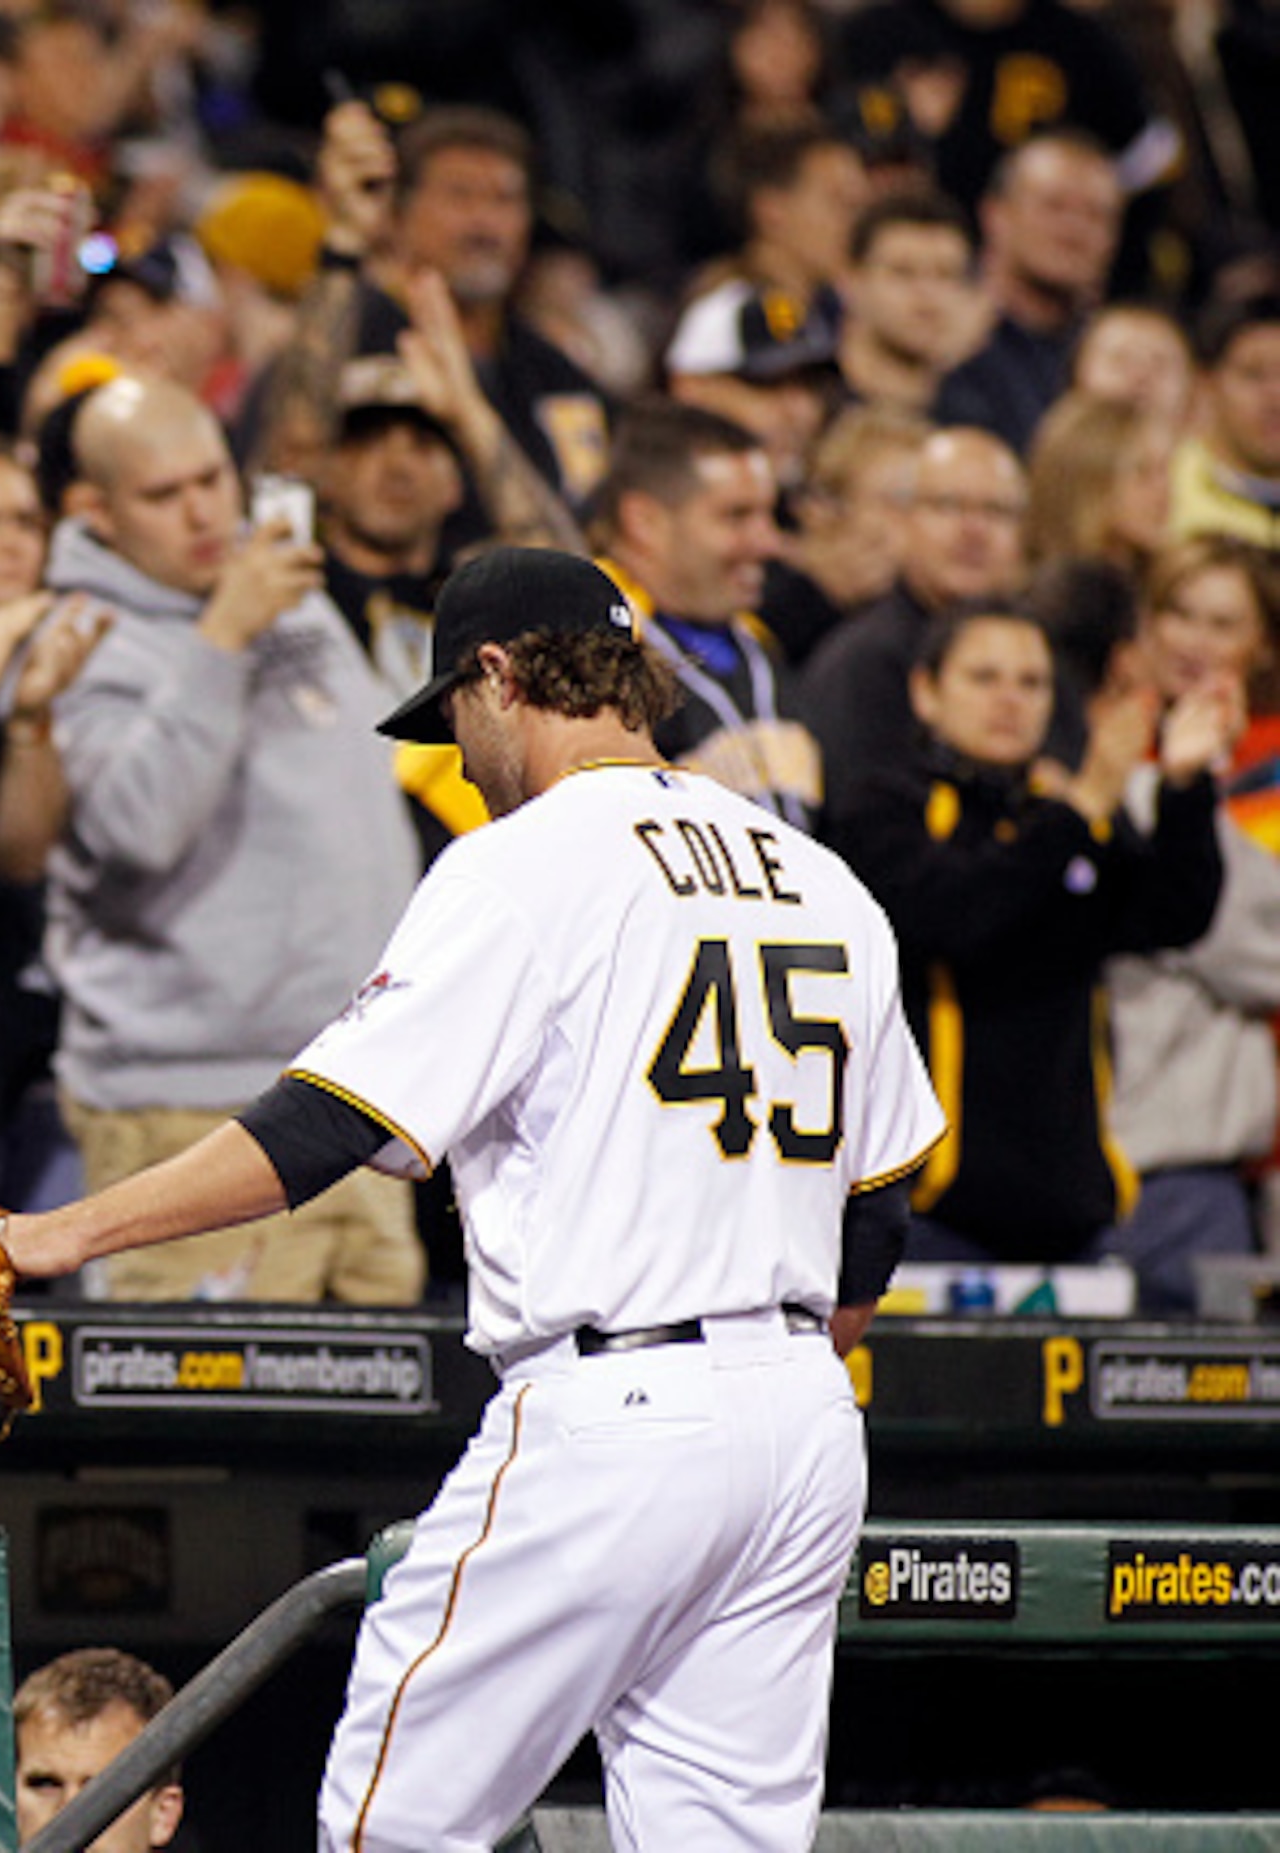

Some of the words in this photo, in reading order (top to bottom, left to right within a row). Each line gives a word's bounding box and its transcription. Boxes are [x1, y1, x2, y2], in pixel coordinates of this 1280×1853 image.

[634, 819, 802, 905] COLE
[645, 935, 851, 1166] 45
[22, 1322, 62, 1413] P
[1043, 1337, 1083, 1427] P
[865, 1549, 1011, 1606] @Pirates
